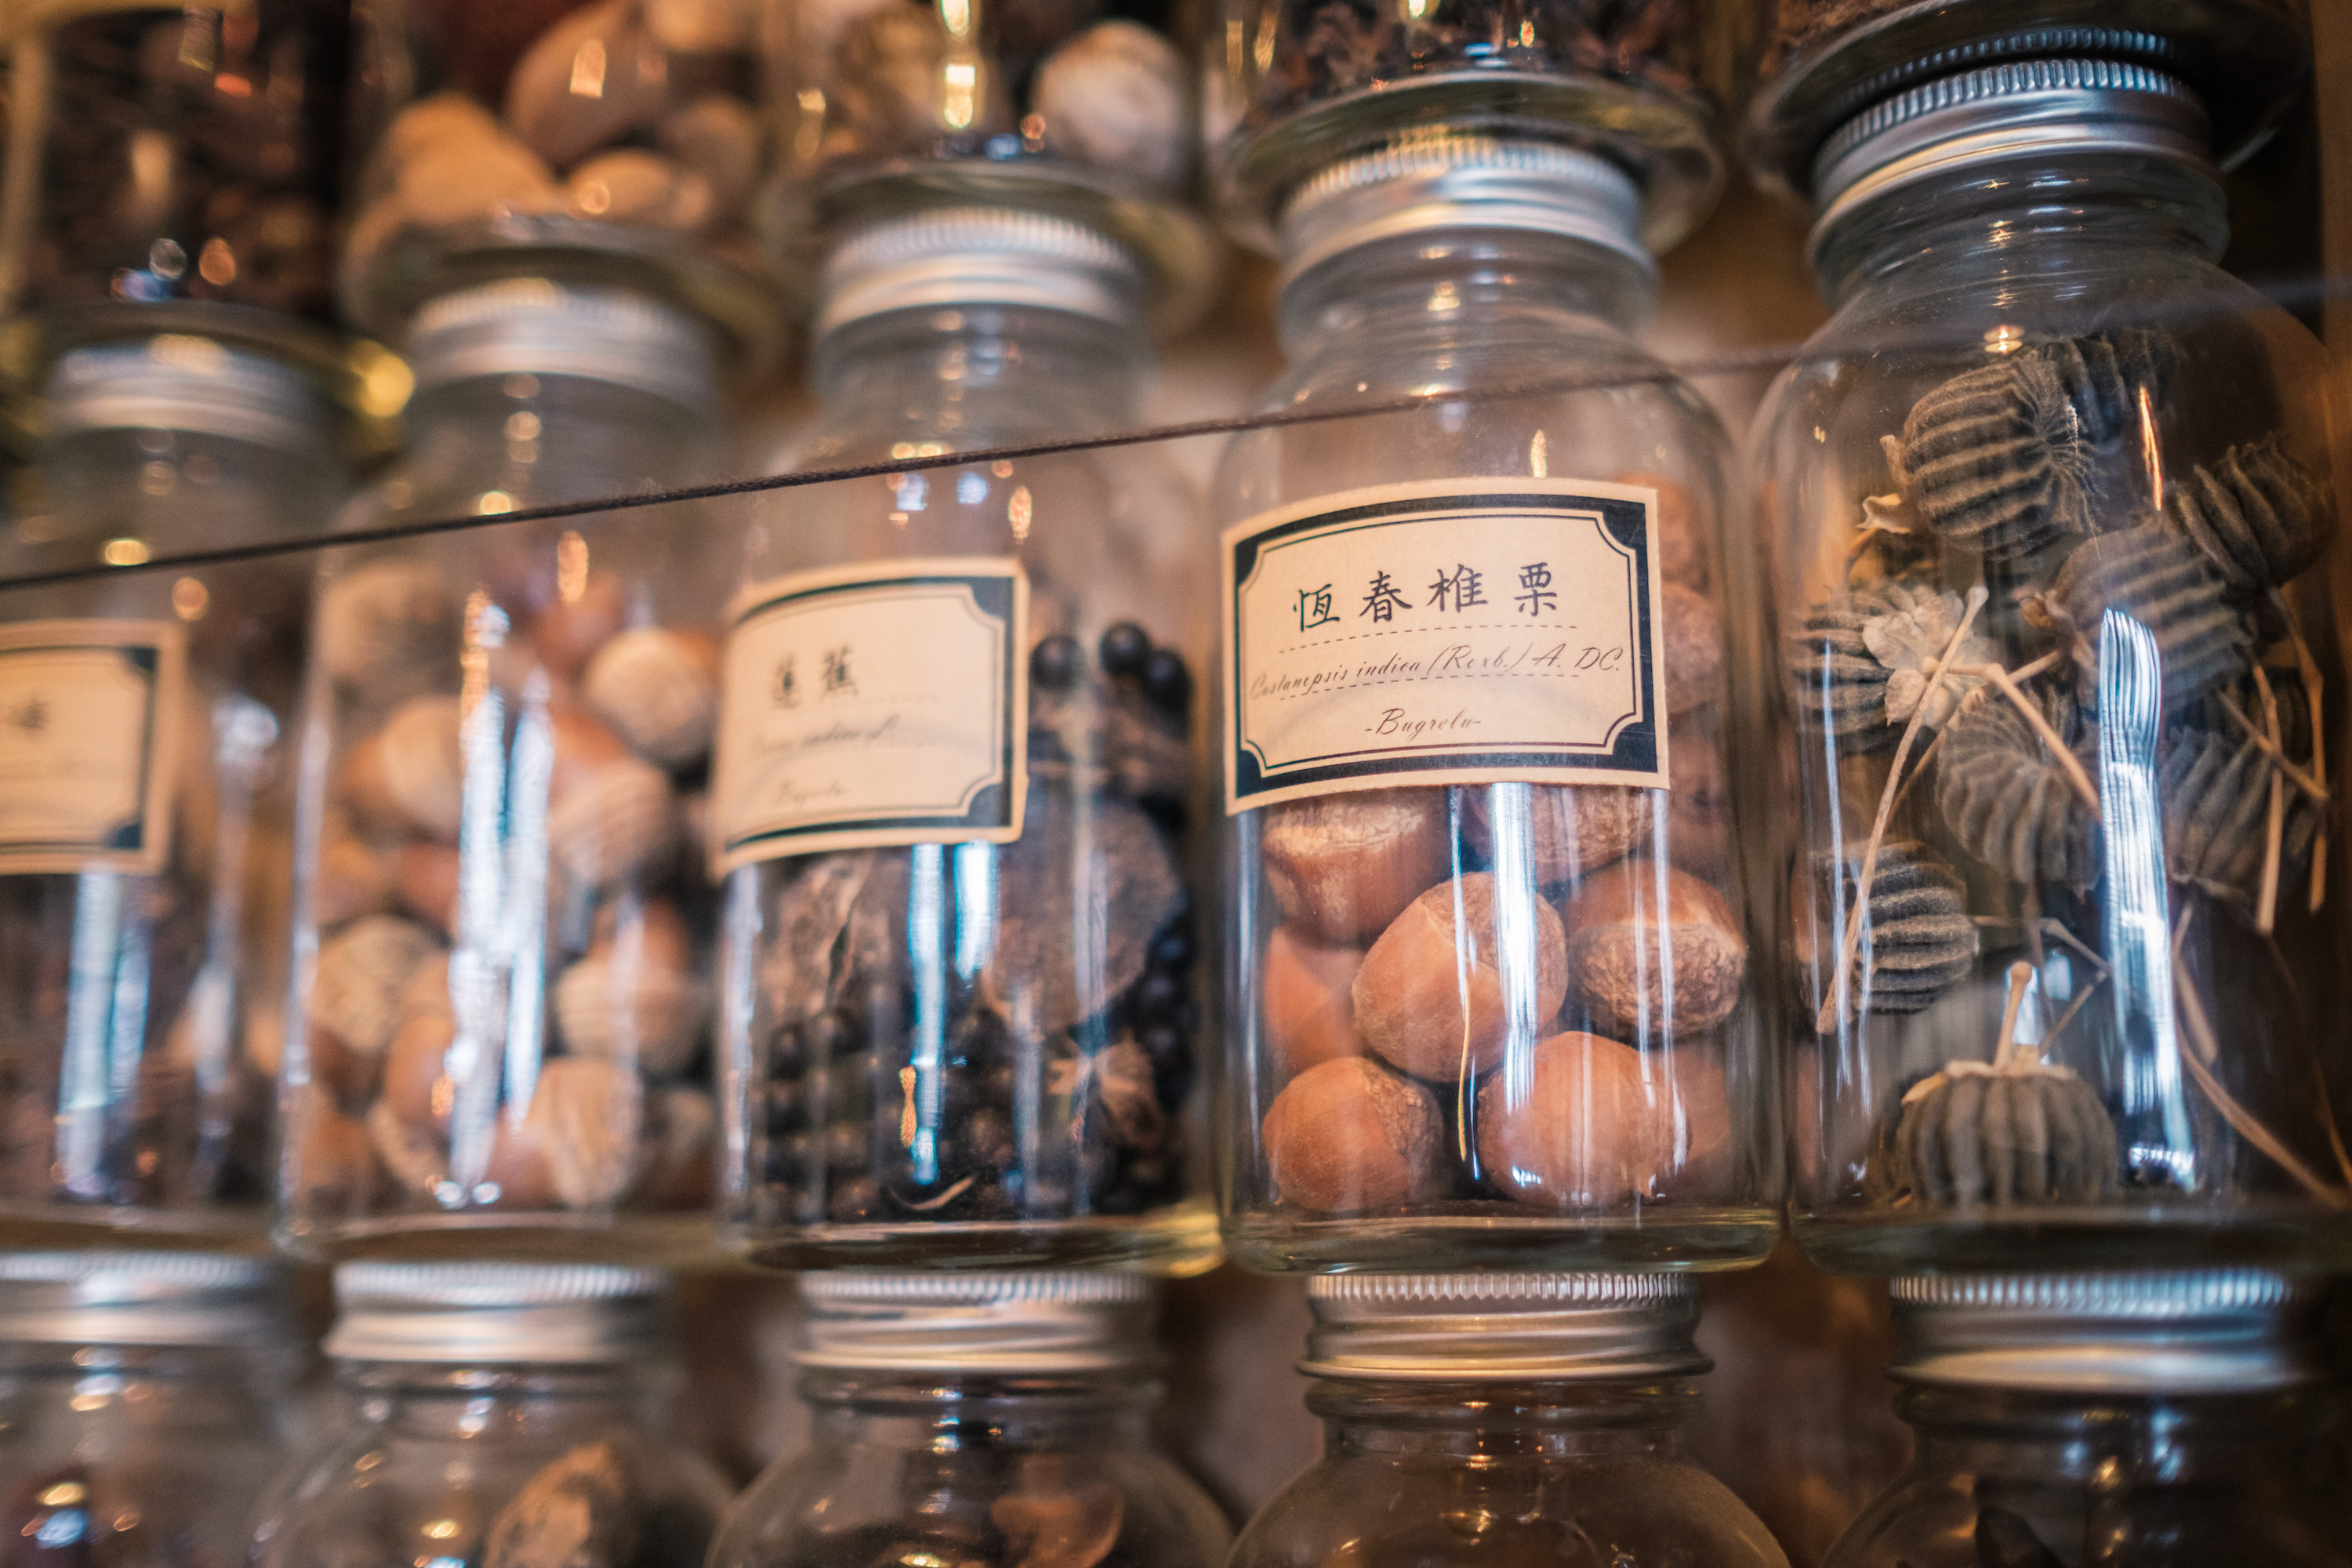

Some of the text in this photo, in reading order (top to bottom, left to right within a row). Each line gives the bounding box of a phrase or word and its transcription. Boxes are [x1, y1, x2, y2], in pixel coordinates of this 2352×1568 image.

[1293, 561, 1558, 633] 恆春椎栗
[1357, 652, 1421, 678] indica
